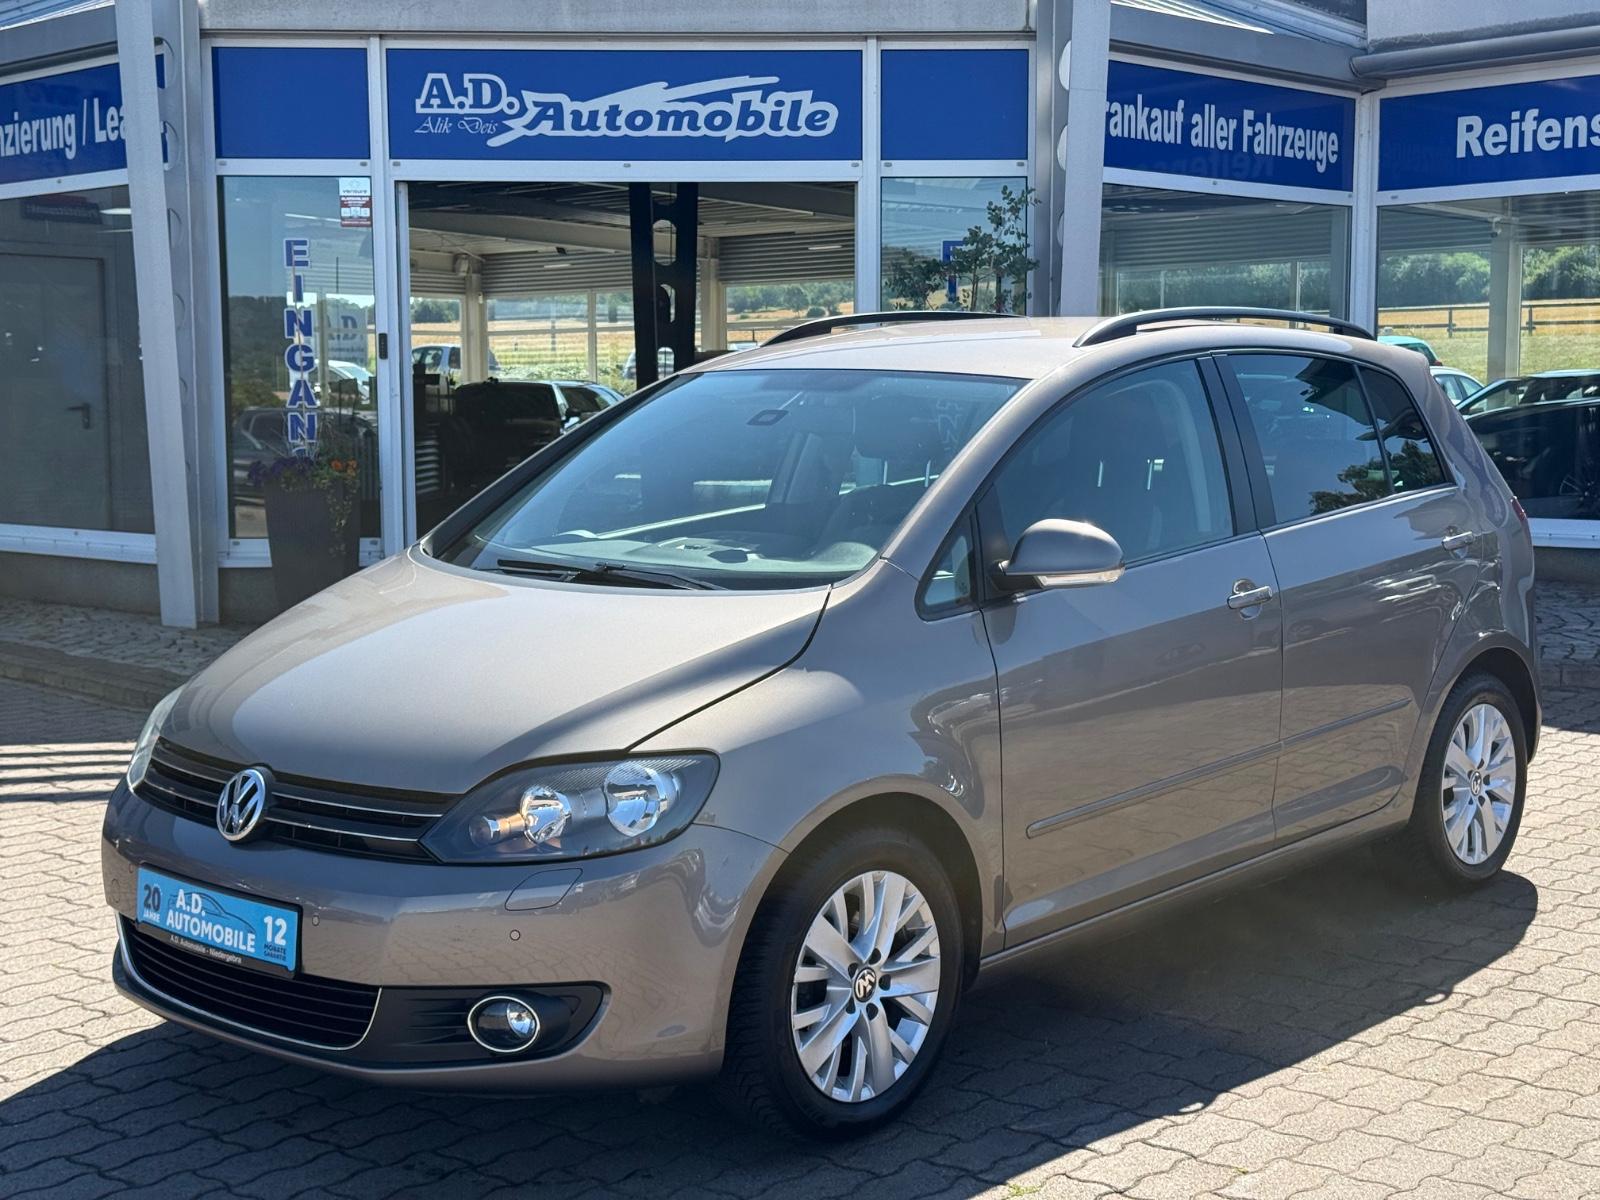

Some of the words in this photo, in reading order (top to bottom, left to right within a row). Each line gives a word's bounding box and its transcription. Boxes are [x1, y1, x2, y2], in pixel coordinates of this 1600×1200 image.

[414, 116, 452, 134] Alik
[457, 116, 498, 134] Deis
[415, 73, 520, 115] A.D.
[515, 84, 839, 143] Automobile
[1190, 103, 1237, 151] aller
[1242, 109, 1339, 174] Fahrzeuge
[283, 238, 317, 457] EINGAN
[143, 883, 161, 912] 20
[175, 888, 206, 917] A.D.
[166, 909, 256, 953] AUTOMOBILE
[263, 915, 287, 946] 12
